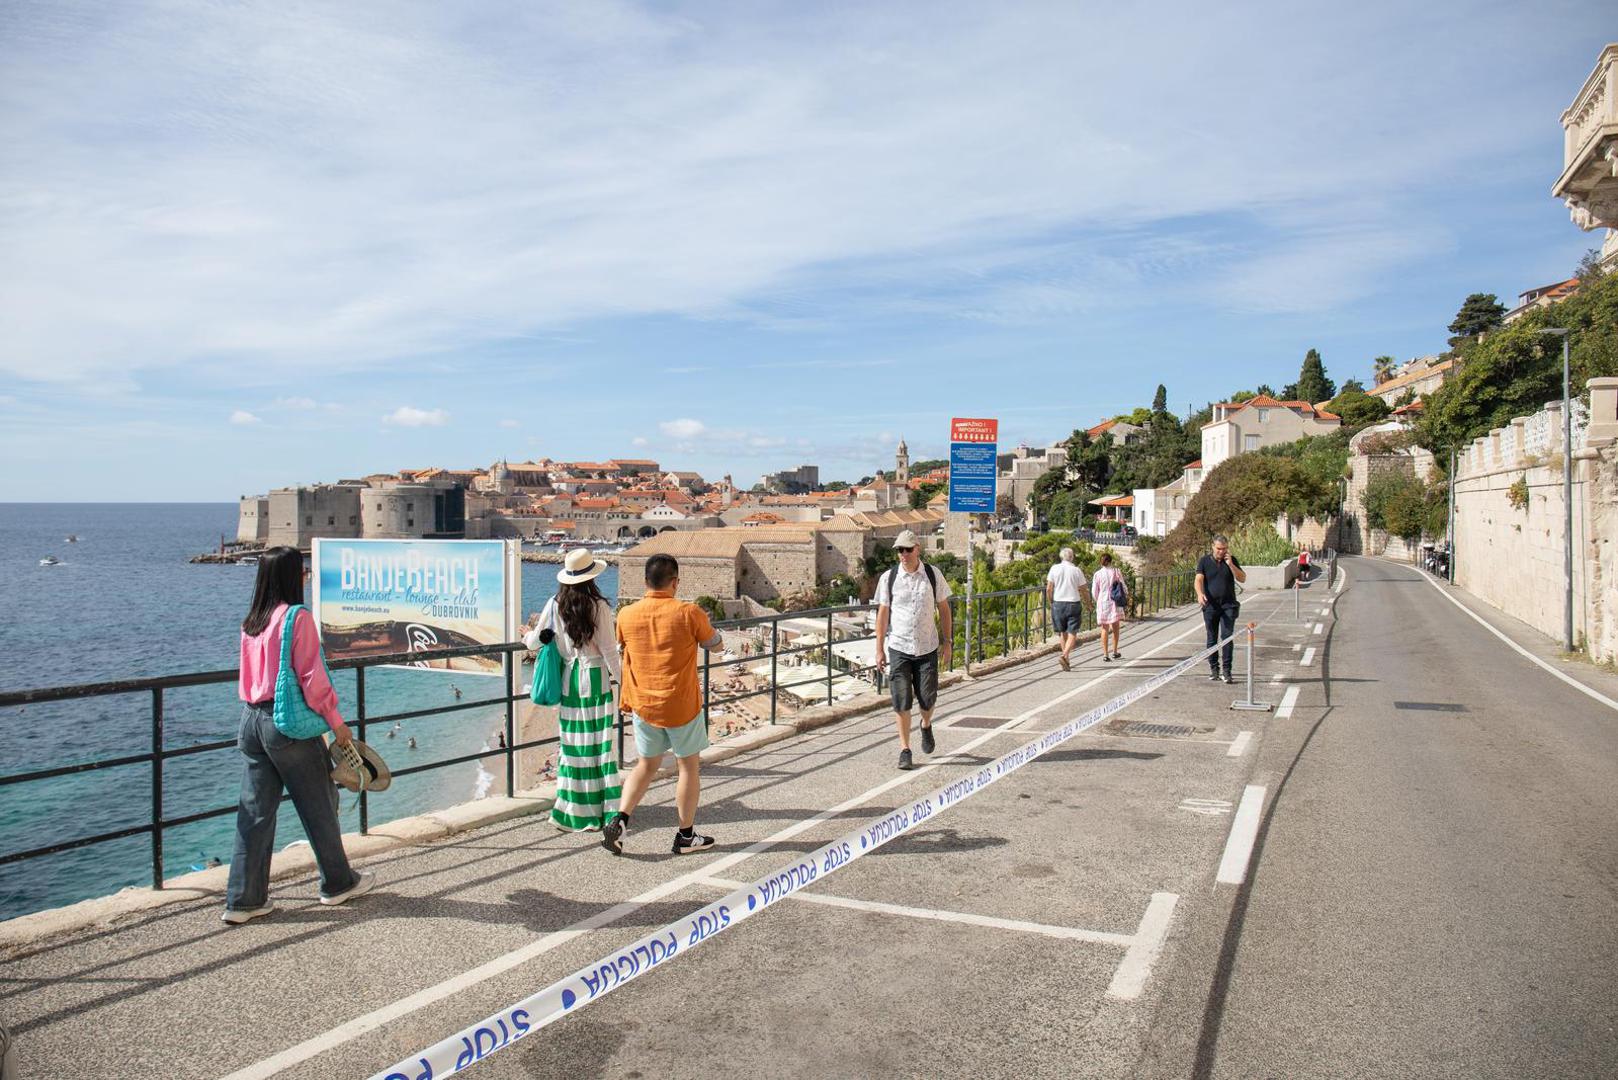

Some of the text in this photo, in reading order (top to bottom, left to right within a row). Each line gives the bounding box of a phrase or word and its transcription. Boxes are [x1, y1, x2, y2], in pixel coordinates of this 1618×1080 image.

[341, 587, 392, 602] restaurant
[405, 586, 440, 616] lounge
[454, 588, 479, 606] club
[432, 605, 479, 620] DUBROVNIK
[944, 777, 973, 804] POLICIJA
[977, 767, 992, 787] STOP
[913, 799, 932, 823] STOP
[867, 811, 909, 845] POLICIJA
[824, 842, 851, 873] STOP
[758, 859, 818, 905] POLICIJA
[689, 905, 730, 945] STOP
[580, 932, 678, 998] POLICIJA
[455, 1009, 531, 1071] STOP
